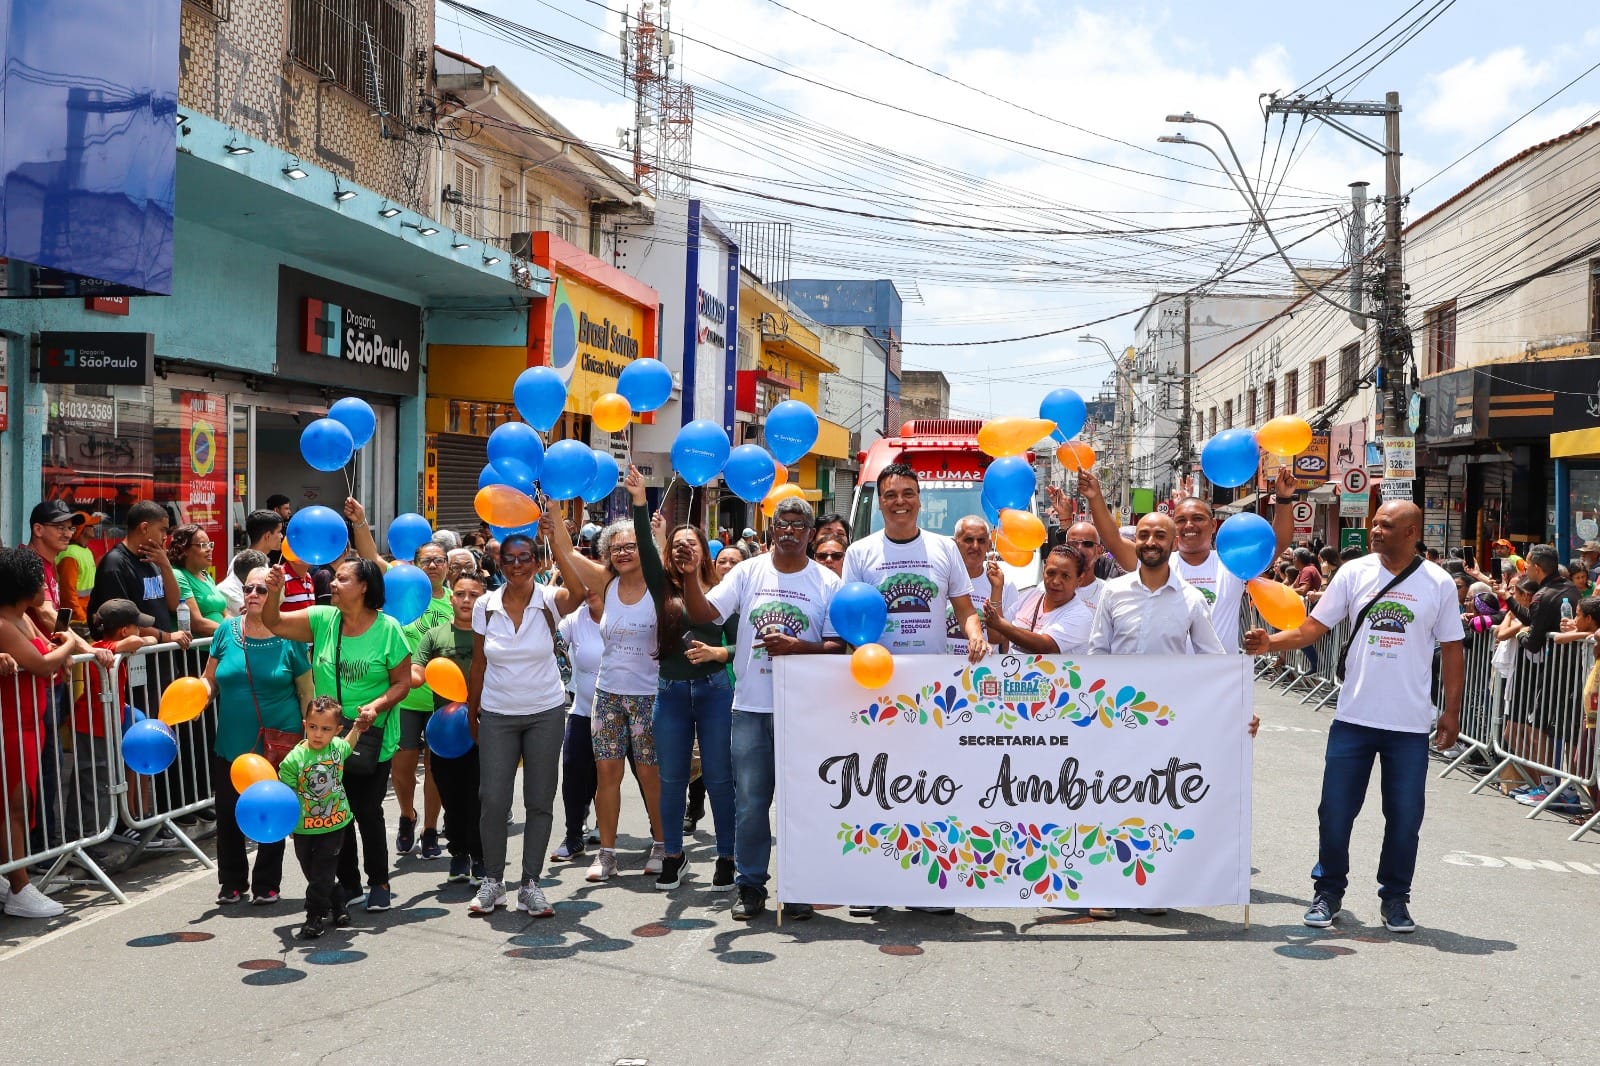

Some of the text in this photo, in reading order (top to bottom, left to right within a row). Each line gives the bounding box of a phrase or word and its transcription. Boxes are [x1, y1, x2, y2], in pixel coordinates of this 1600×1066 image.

[347, 308, 376, 329] Drogaria
[579, 311, 638, 360] Brasil Sorriso
[346, 328, 410, 372] SãoPaulo
[80, 355, 138, 368] SãoPaulo
[1350, 473, 1360, 489] E
[1297, 506, 1306, 519] E
[1003, 679, 1040, 693] FERRAZ
[959, 735, 1069, 746] SECRETARIA DE
[818, 751, 1210, 811] Meio Ambiente
[304, 809, 347, 829] ROCKY
